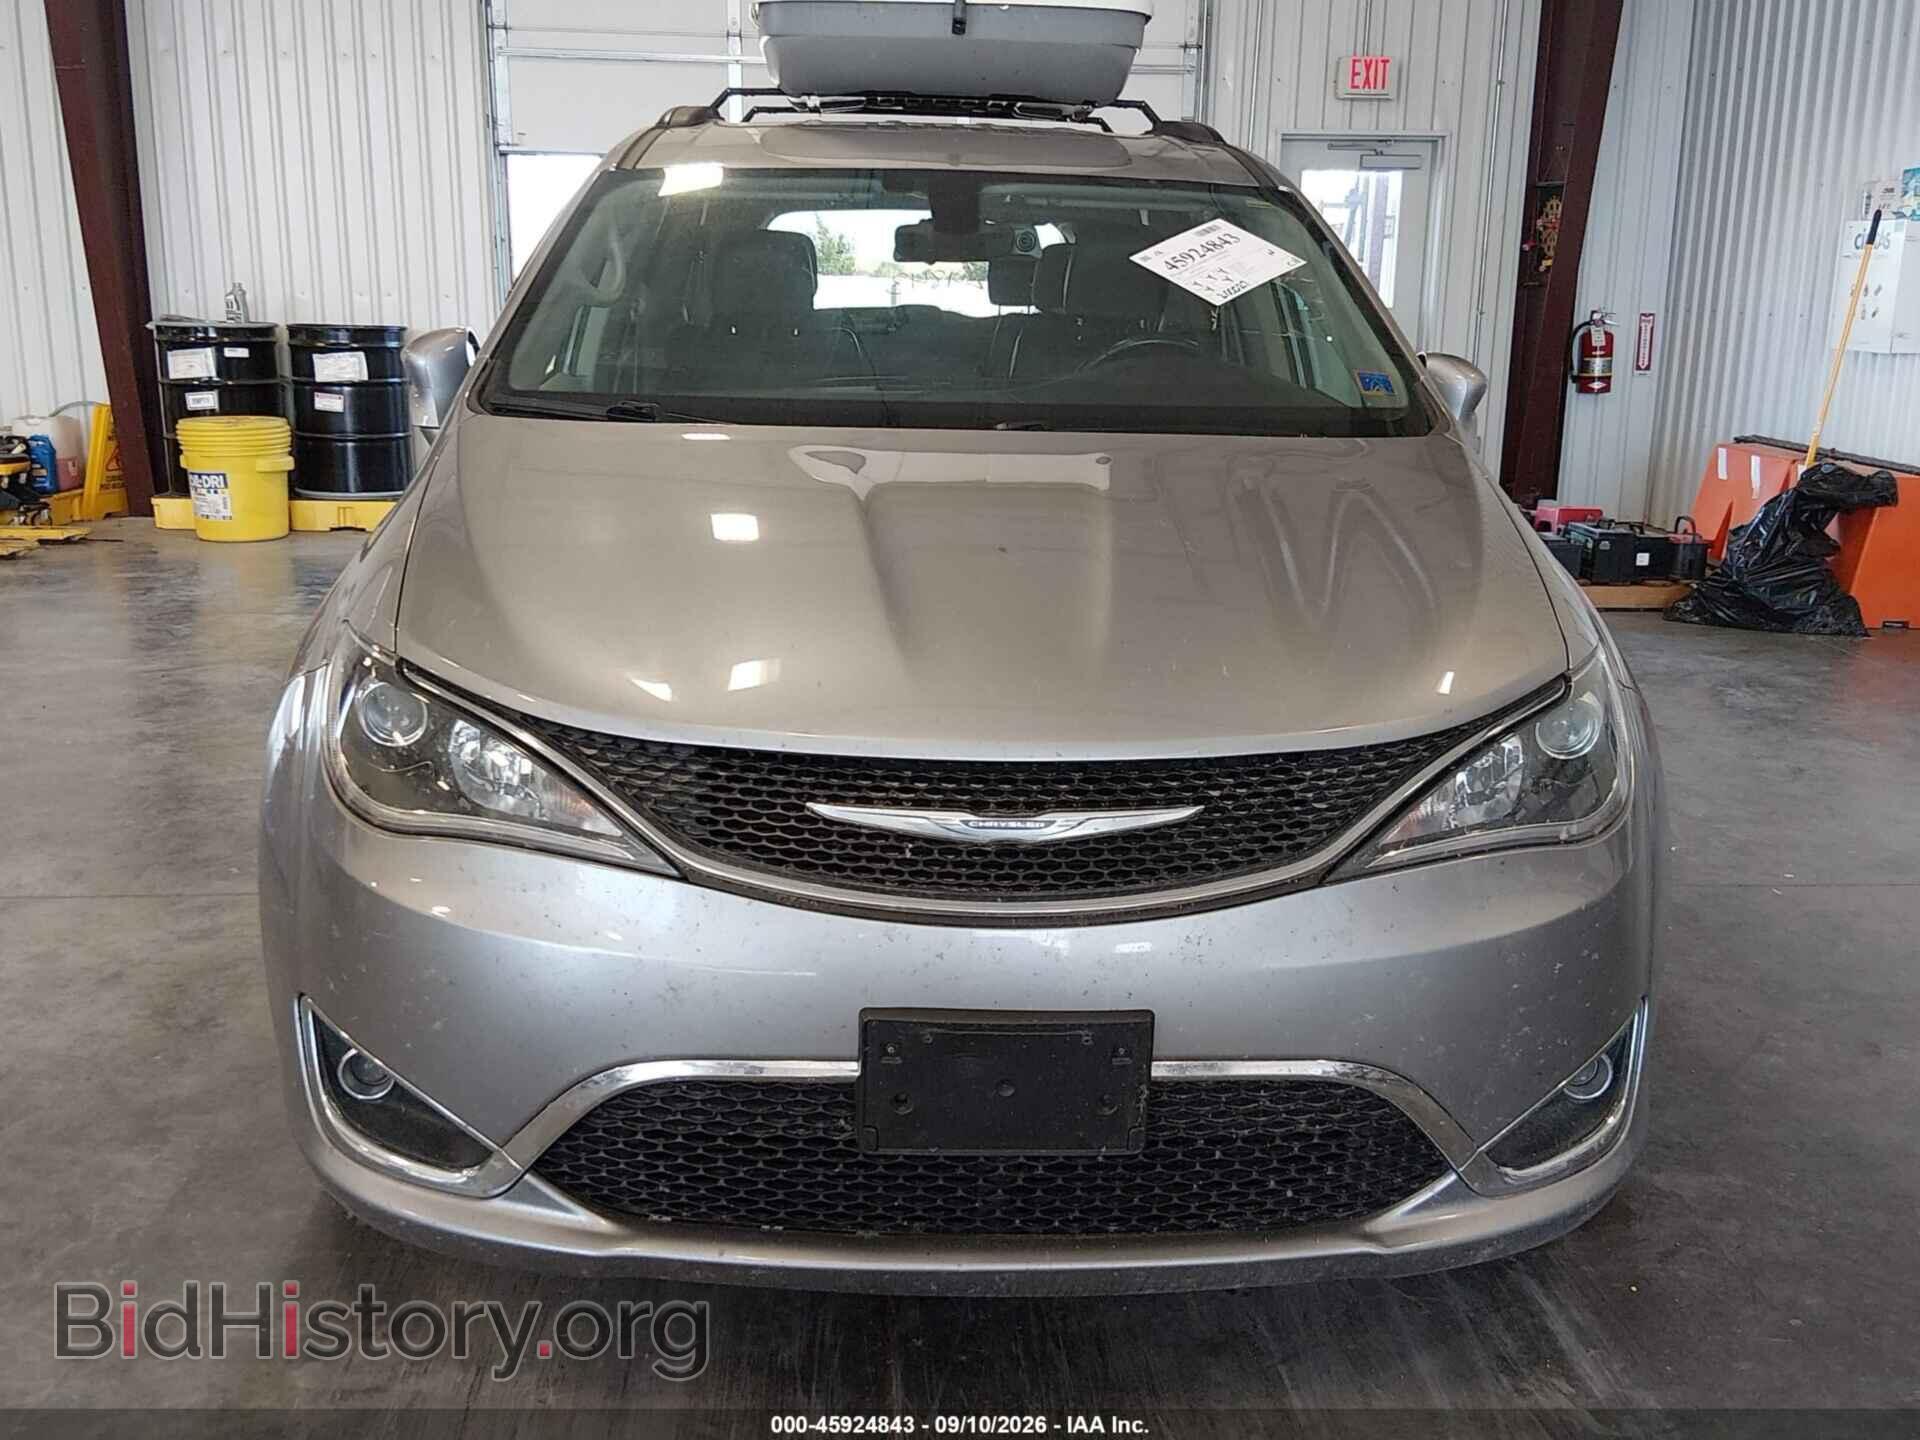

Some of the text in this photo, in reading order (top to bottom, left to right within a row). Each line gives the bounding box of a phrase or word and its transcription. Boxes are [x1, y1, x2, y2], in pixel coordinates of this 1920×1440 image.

[1350, 58, 1390, 90] EXIT
[1163, 233, 1241, 272] 45924843
[969, 820, 1045, 829] CHRYSLER
